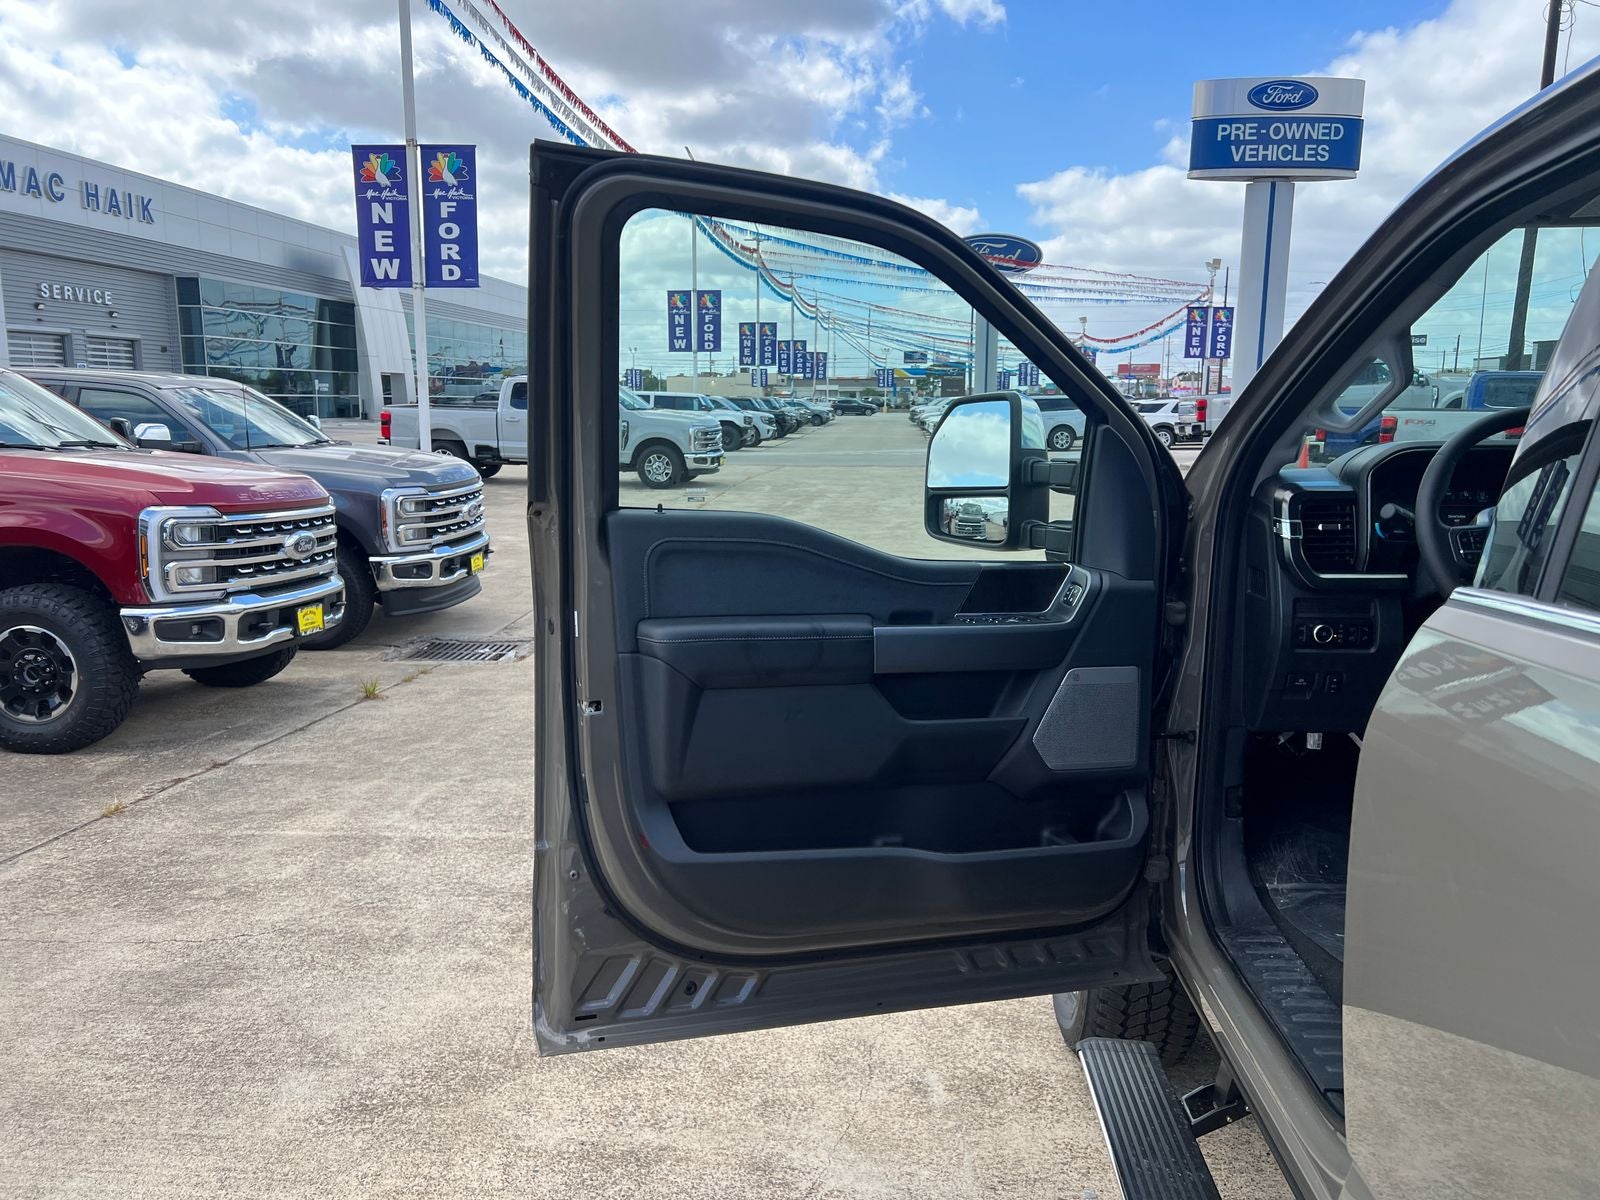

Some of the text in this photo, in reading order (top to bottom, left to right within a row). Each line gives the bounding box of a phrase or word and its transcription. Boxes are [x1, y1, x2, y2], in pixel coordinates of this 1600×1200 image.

[1262, 85, 1304, 104] Ford
[1216, 122, 1345, 141] PRE-OWNED
[1230, 144, 1330, 162] VEHICLES
[0, 160, 154, 224] MAC HAIK
[371, 202, 400, 280] NEW
[438, 202, 461, 281] FORD
[40, 283, 112, 305] SERVICE
[674, 315, 686, 349] NEW
[704, 315, 714, 350] FORD
[1190, 327, 1201, 356] NEW
[1216, 327, 1226, 357] FORD
[743, 340, 752, 364] NEW
[764, 340, 772, 365] FORD
[780, 353, 788, 373] NEW
